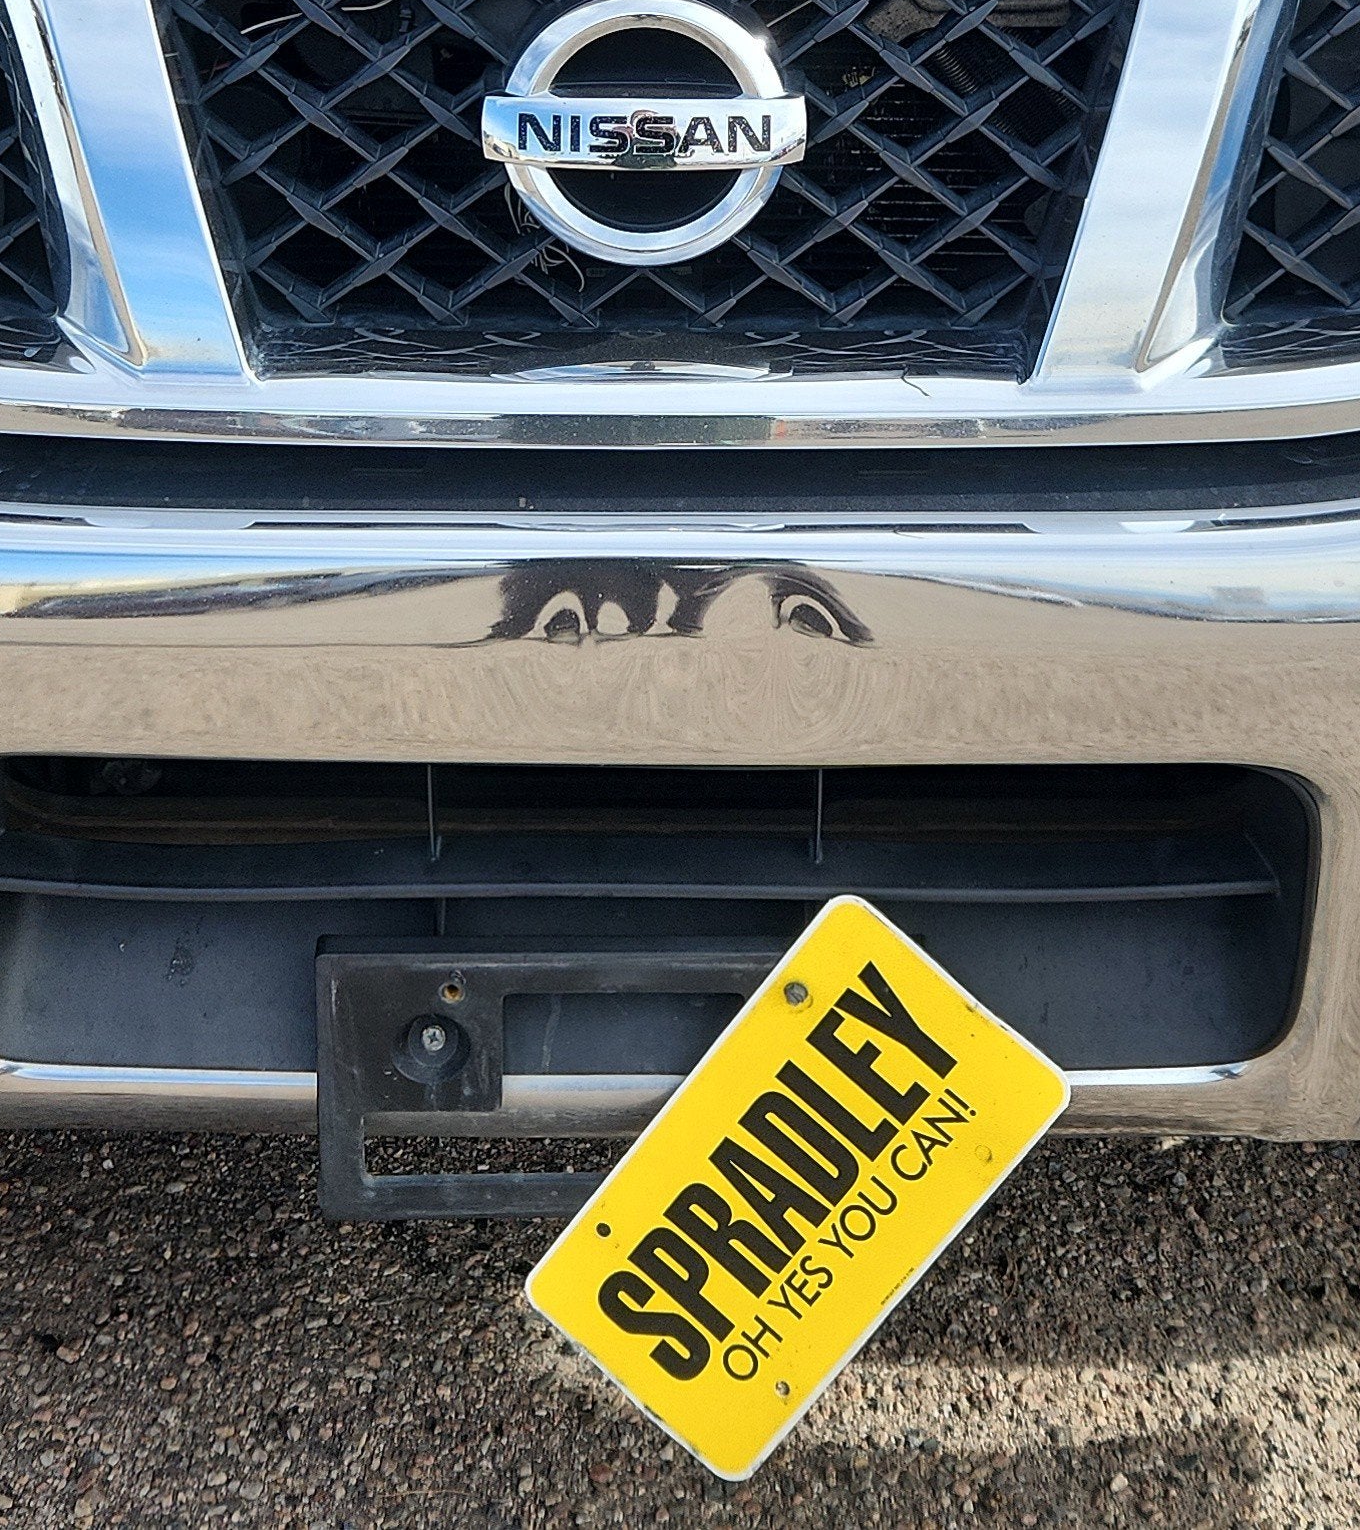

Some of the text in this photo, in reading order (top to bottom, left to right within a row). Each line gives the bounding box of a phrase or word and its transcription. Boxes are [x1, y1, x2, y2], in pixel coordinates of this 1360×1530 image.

[517, 111, 772, 155] NISSAN
[597, 961, 957, 1382] SPRADLEY
[721, 1317, 783, 1382] OH
[771, 1254, 834, 1324] YES
[818, 1175, 897, 1258] YOU
[889, 1087, 978, 1183] CAN!
